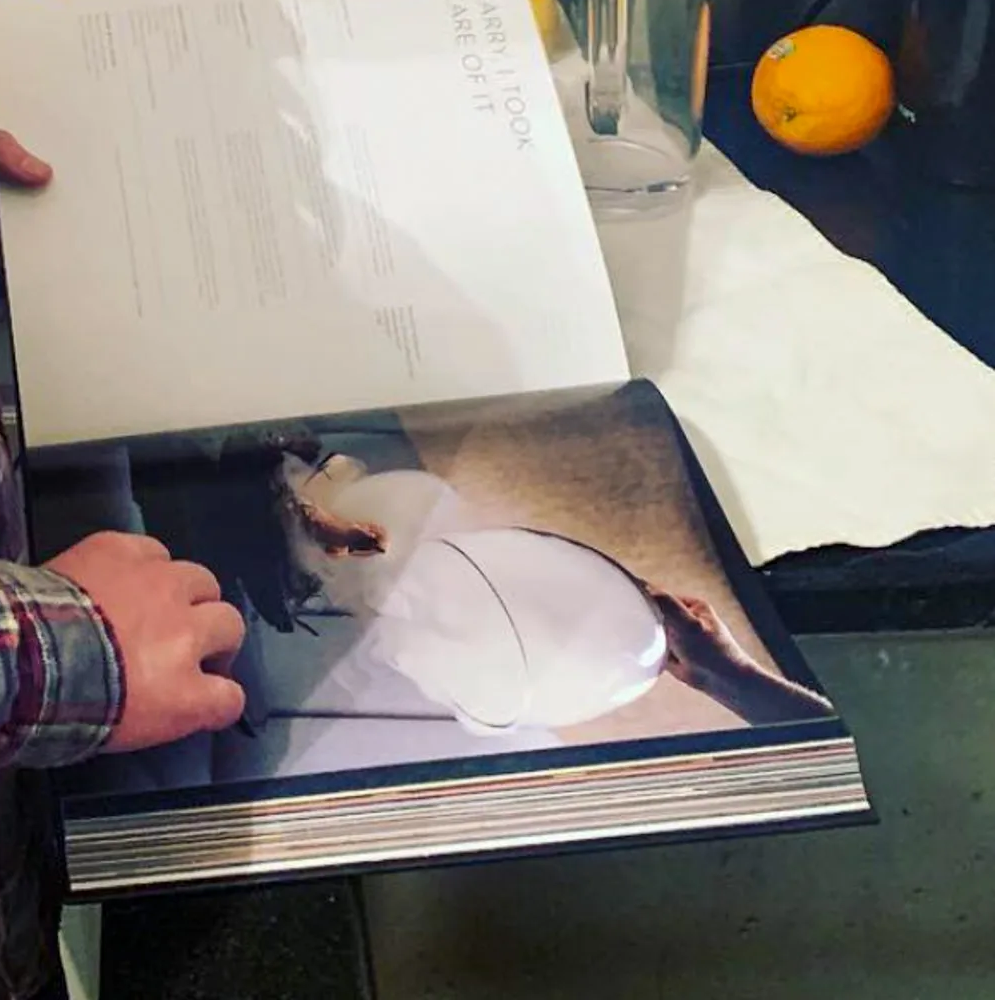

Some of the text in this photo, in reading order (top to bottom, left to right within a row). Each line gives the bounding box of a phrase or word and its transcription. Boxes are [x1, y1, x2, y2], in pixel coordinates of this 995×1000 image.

[461, 53, 490, 85] OF
[472, 93, 496, 115] IT
[501, 84, 535, 150] TOOK
